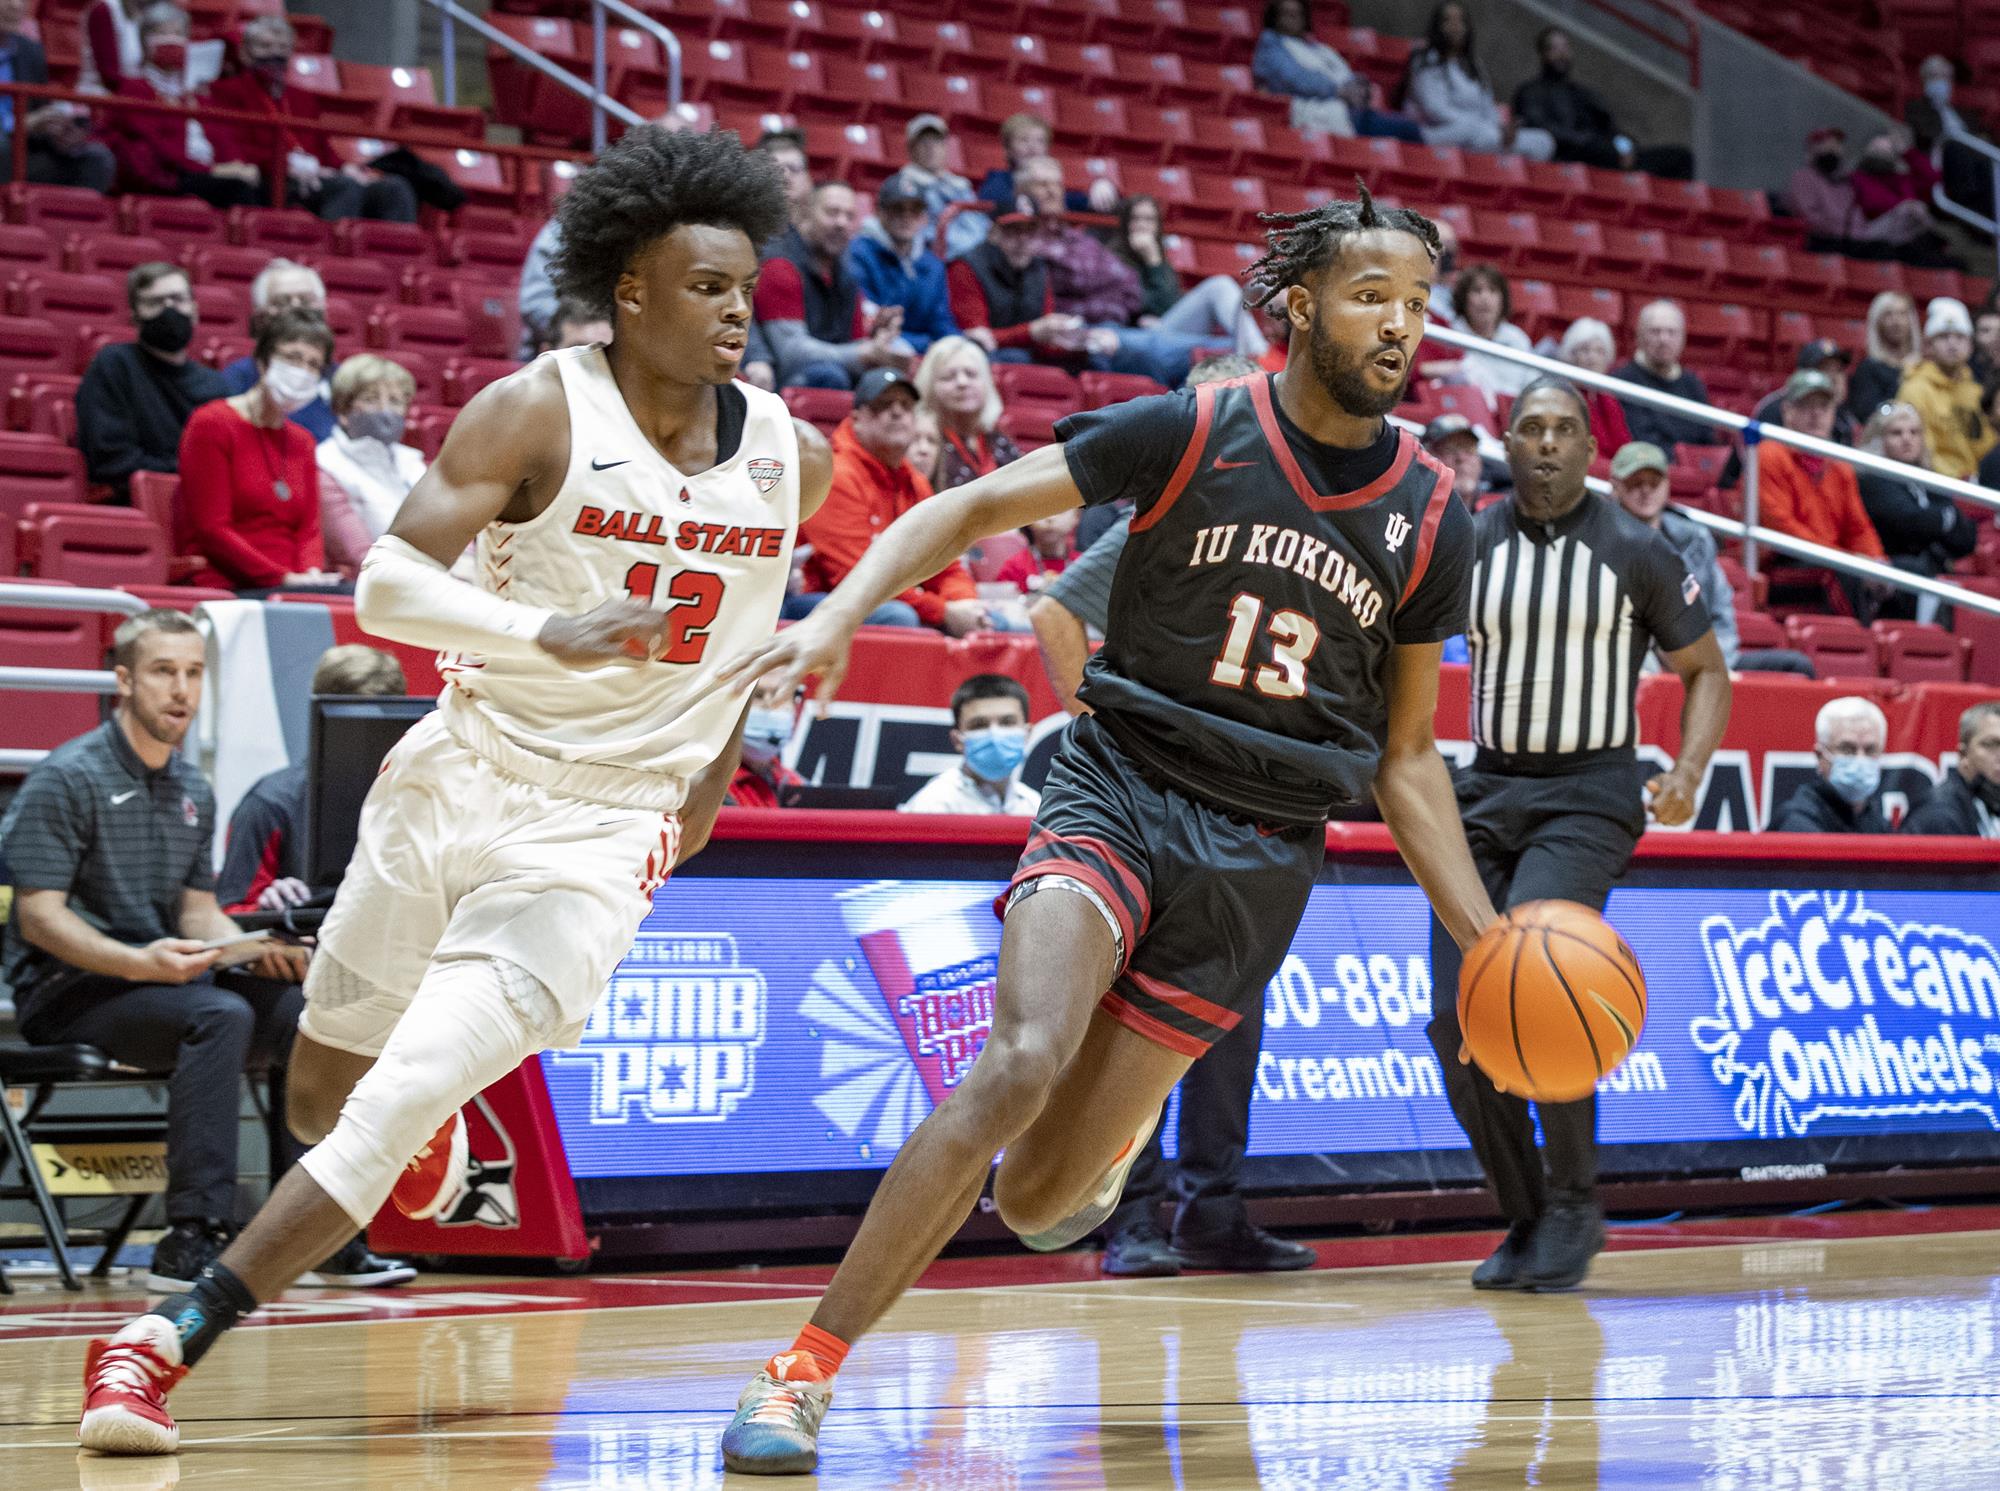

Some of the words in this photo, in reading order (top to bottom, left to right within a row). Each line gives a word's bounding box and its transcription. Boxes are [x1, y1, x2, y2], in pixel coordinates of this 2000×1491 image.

[572, 505, 668, 546] BALL
[675, 520, 787, 558] STATE
[1188, 524, 1239, 567] IU
[1241, 524, 1384, 630] KOKOMO
[1208, 591, 1321, 700] 13
[1713, 915, 2000, 1031] IceCream
[599, 1046, 748, 1114] POP
[1254, 1048, 1445, 1100] CreamOn
[1768, 1012, 1994, 1101] OnWheels
